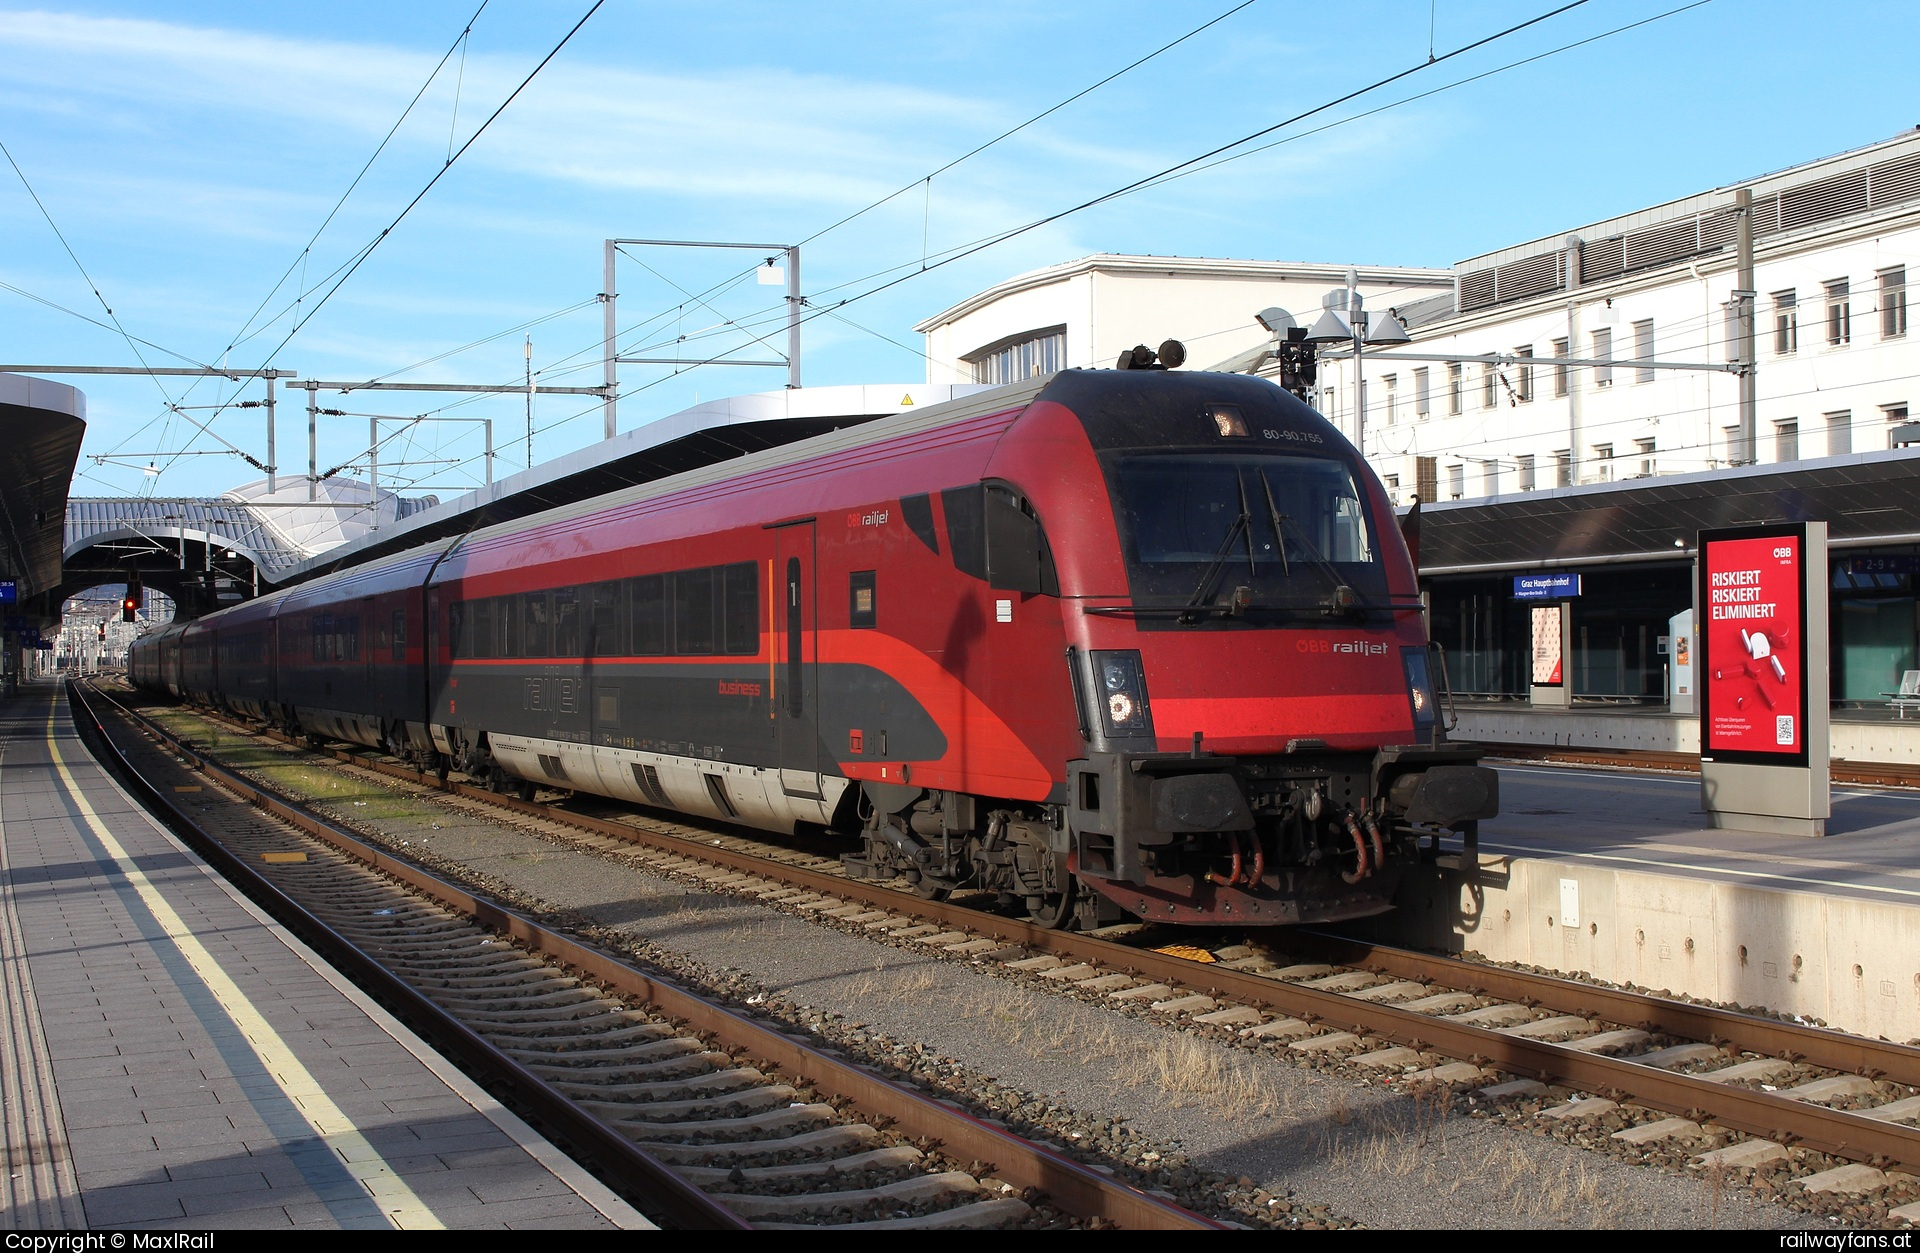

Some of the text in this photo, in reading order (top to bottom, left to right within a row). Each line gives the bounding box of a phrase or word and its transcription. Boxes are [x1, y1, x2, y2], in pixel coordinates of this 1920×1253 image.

[1263, 429, 1323, 444] 80-90.755
[847, 510, 889, 528] ÖBB railjet
[1773, 547, 1792, 558] ÖBB
[1866, 559, 1884, 570] 2-9
[1521, 577, 1570, 588] Graz Hauptbahnhof
[1711, 570, 1761, 587] RISKIERT
[790, 582, 796, 606] 1
[1712, 587, 1761, 603] RISKIERT
[1712, 603, 1776, 620] ELIMINIERT
[1296, 639, 1389, 656] ÖBB railjet
[524, 665, 582, 725] railjet
[718, 679, 761, 697] business
